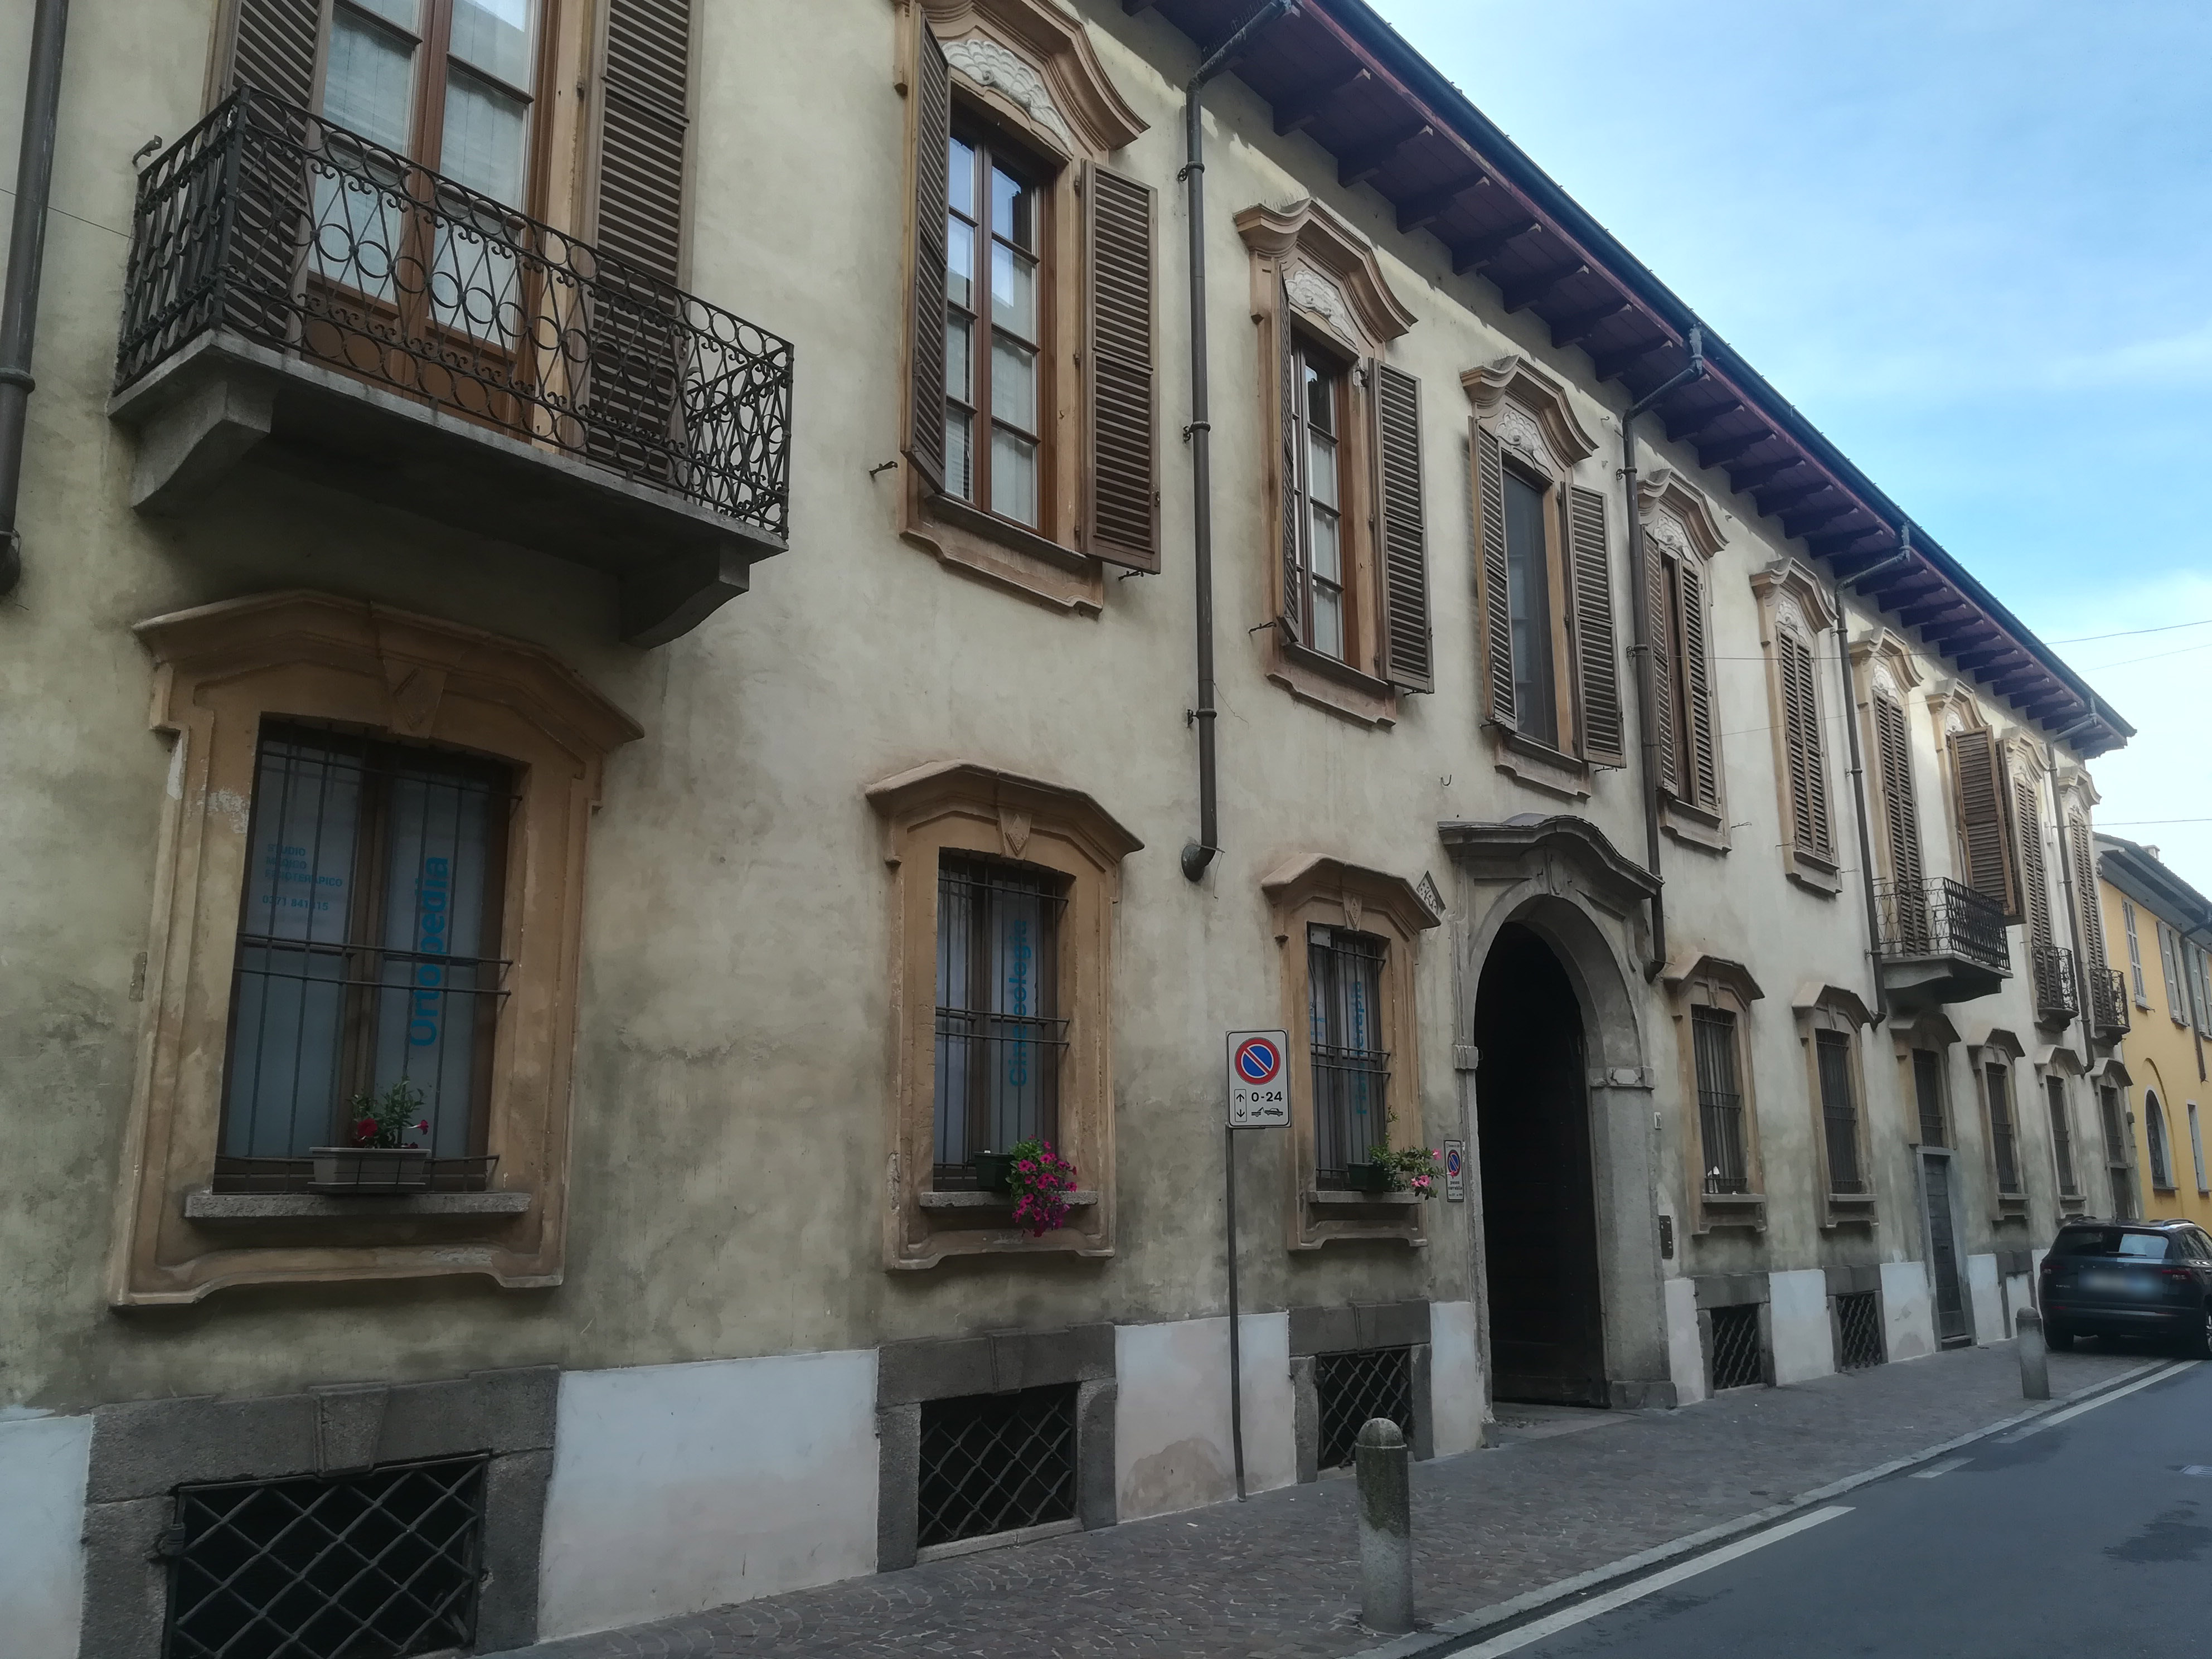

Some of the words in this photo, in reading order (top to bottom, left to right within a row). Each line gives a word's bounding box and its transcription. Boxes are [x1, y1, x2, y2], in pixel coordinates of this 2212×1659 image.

[265, 856, 307, 869] MDICO
[291, 899, 328, 910] 84115
[410, 857, 448, 1046] Ortopedia
[1008, 919, 1031, 1086] Ginecologia
[1251, 1091, 1283, 1102] 0-24
